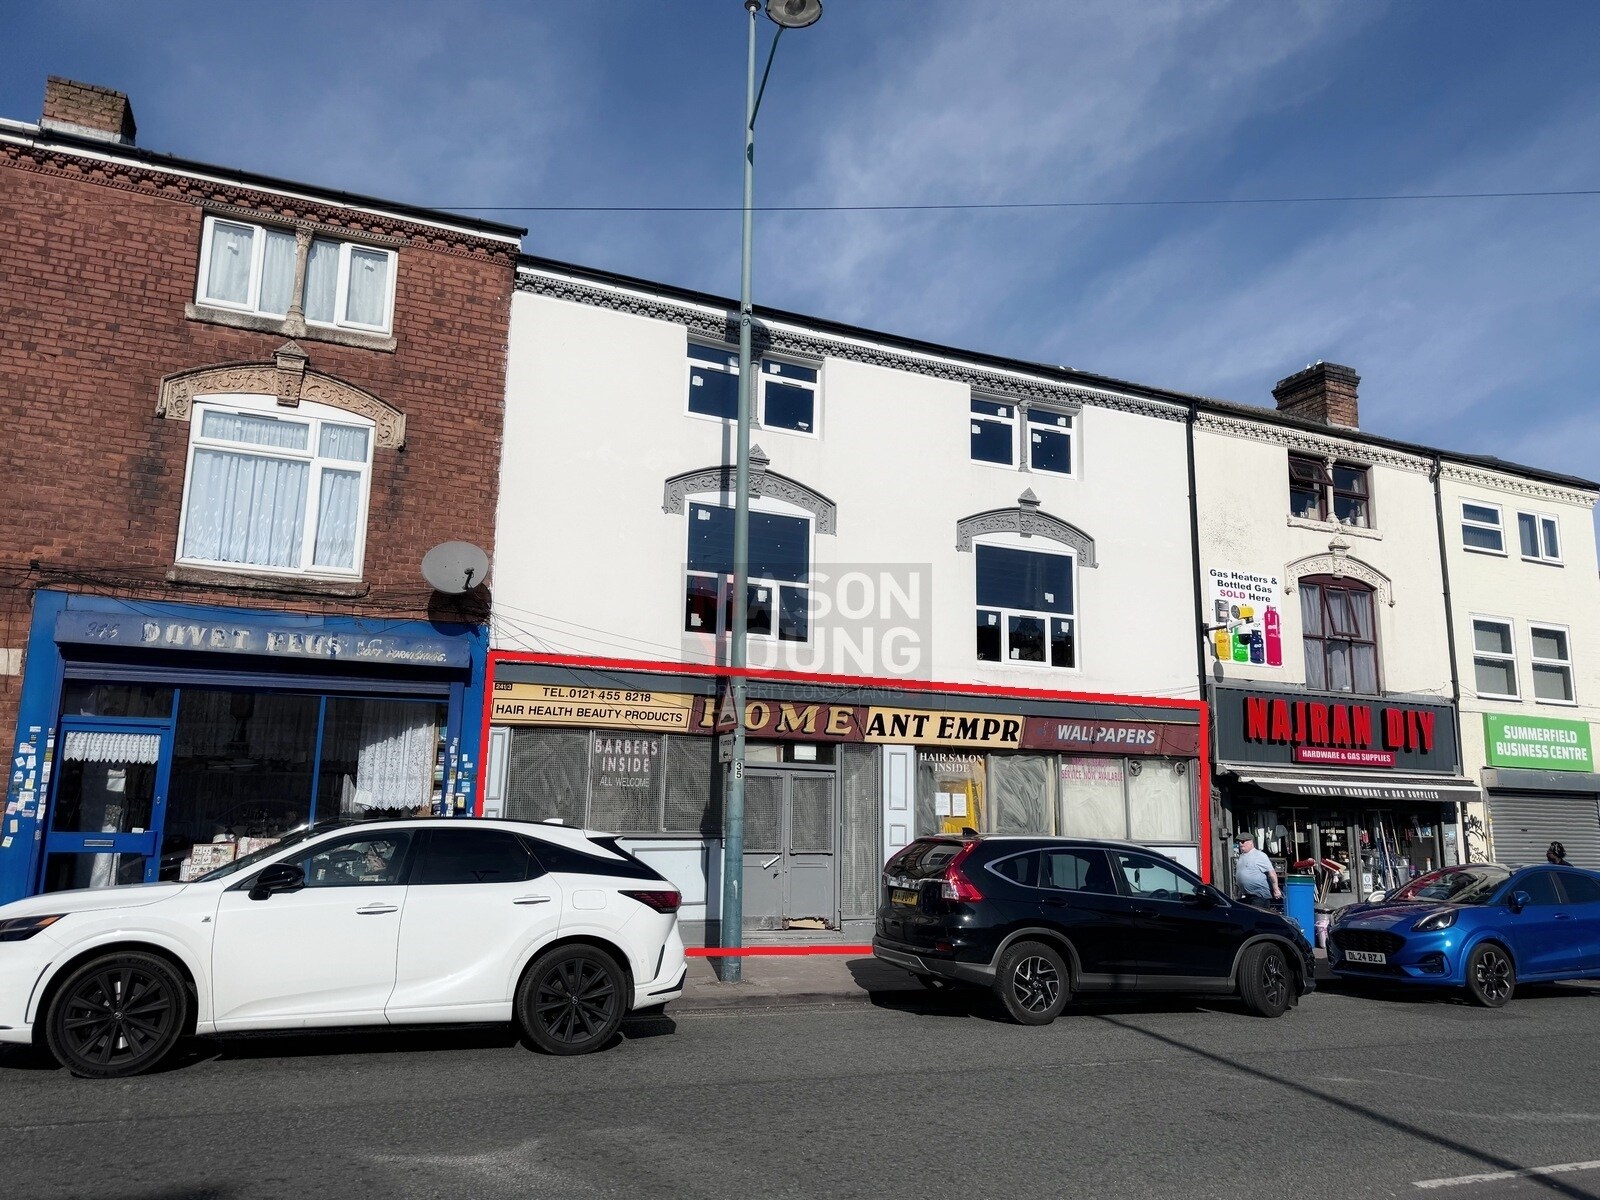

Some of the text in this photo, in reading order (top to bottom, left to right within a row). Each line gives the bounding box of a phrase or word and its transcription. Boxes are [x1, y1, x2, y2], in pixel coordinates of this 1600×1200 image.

[1210, 569, 1278, 585] Gas Heaters &
[1217, 580, 1272, 594] Bottled Gas
[1219, 589, 1271, 602] SOLD Here
[543, 687, 651, 702] TEL.0121 455 8218
[496, 704, 683, 722] HAIR HEALTH BEAUTY PRODUCTS
[865, 713, 1020, 742] ANT EMPR
[1247, 696, 1435, 751] NAJRAN DIY
[1503, 724, 1578, 744] SUMMERFIELD
[594, 738, 658, 755] BARBERS
[1495, 741, 1588, 761] BUSINESS CENTRE
[919, 752, 985, 764] HAIR SALON
[1302, 749, 1340, 759] HARDWARE
[1361, 753, 1391, 762] SUPPLIES
[601, 756, 650, 772] INSIDE
[934, 762, 971, 774] INSIDE
[600, 775, 650, 788] ALL WELCOME
[1343, 788, 1381, 798] HARDWARE
[1391, 790, 1405, 798] GAS
[1407, 790, 1439, 799] SUPPLIES
[1347, 951, 1383, 963] DL24 BZJ
